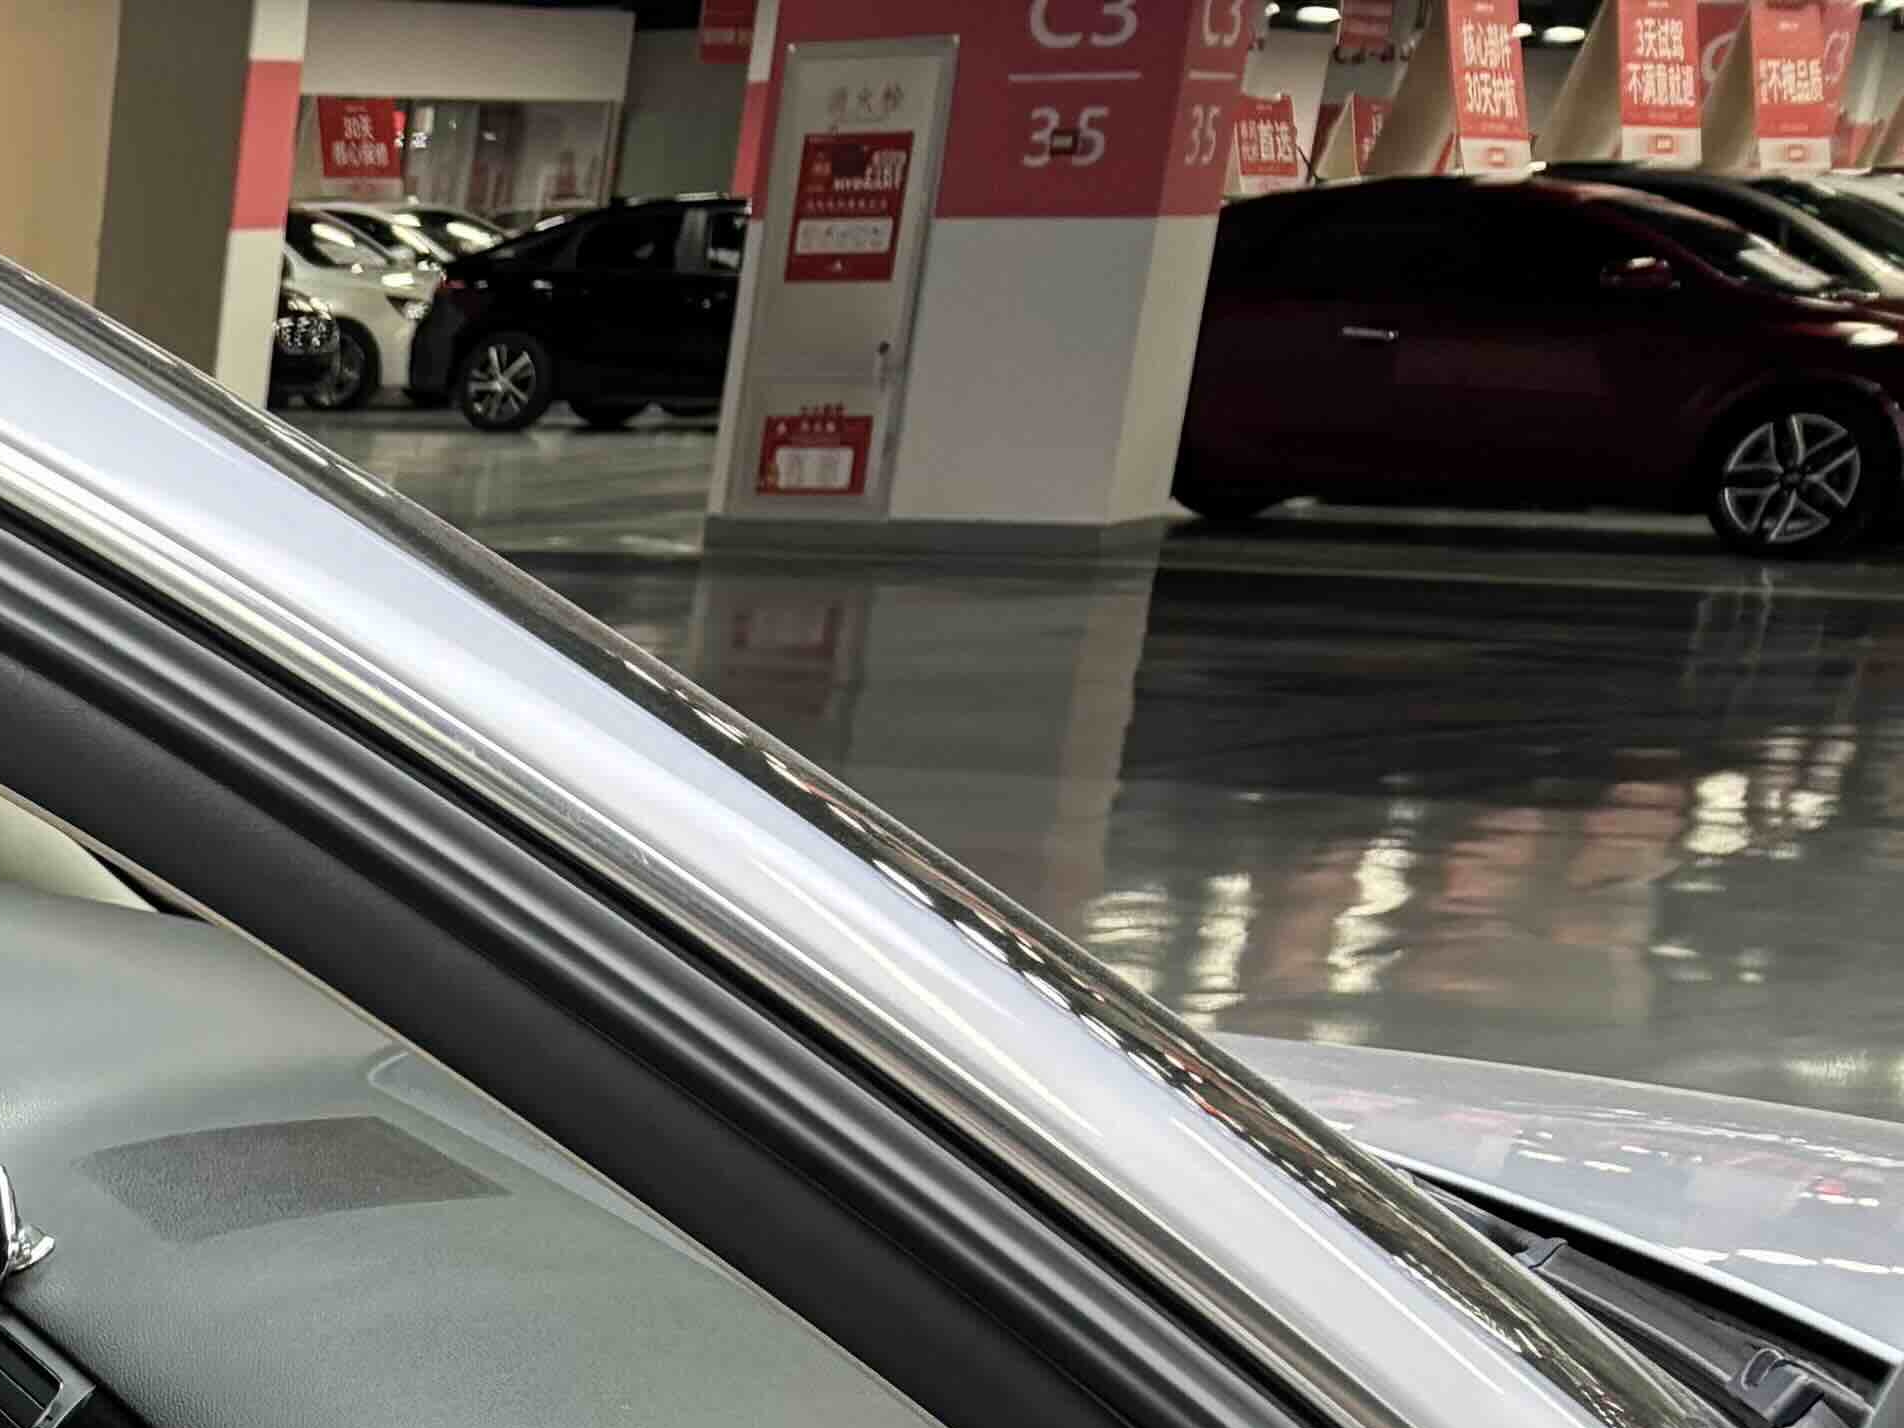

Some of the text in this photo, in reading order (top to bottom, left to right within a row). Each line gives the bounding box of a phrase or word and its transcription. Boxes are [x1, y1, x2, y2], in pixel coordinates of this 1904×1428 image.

[1633, 17, 1685, 62] 3天试驾
[1184, 104, 1222, 166] 35
